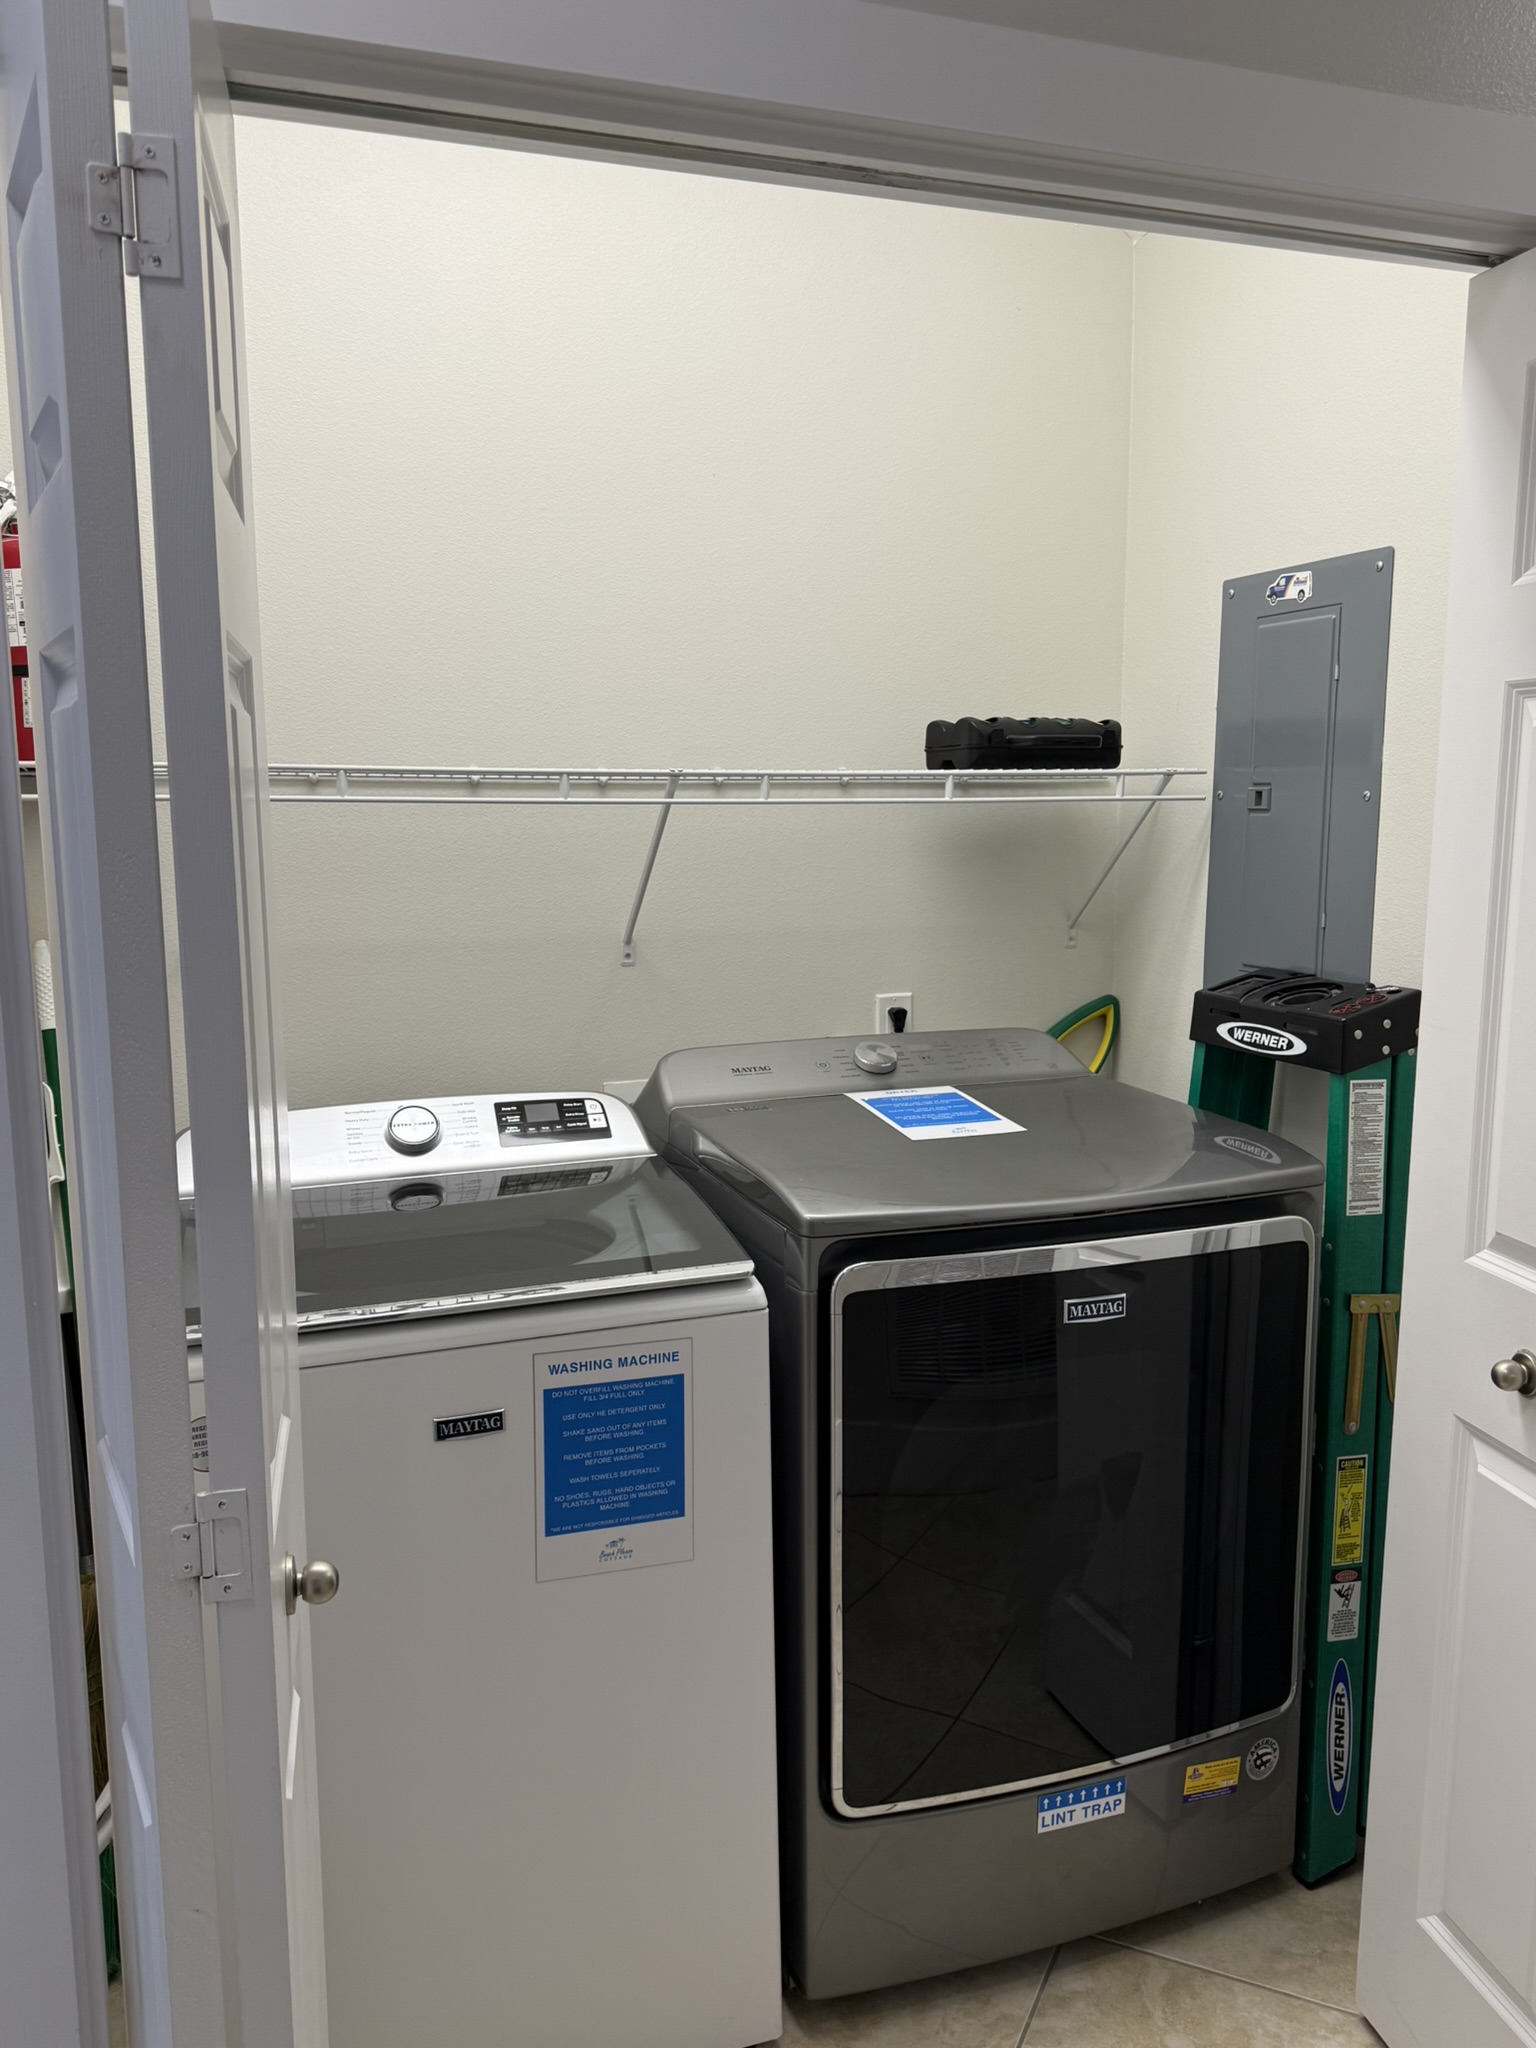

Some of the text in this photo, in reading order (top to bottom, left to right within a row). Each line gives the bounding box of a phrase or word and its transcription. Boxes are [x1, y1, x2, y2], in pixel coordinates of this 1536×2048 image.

[1233, 1027, 1290, 1050] WERNER
[730, 1065, 772, 1074] MAYTAG
[1069, 1300, 1123, 1318] MAYTAG
[548, 1351, 680, 1376] WASHING MACHINE
[552, 1391, 563, 1399] DO
[564, 1389, 578, 1397] NOT
[579, 1385, 611, 1395] OVERFILL
[612, 1381, 644, 1392] WASHING
[583, 1394, 598, 1402] FILL
[598, 1393, 609, 1401] 3/4
[610, 1391, 626, 1400] FULL
[562, 1413, 577, 1421] USE
[577, 1411, 595, 1419] ONLY
[596, 1409, 606, 1417] HE
[607, 1405, 648, 1416] DETERGENT
[438, 1416, 501, 1436] MAYTAG
[562, 1428, 586, 1437] SHAKE
[586, 1426, 606, 1434] SAND
[606, 1424, 621, 1432] OUT
[631, 1421, 646, 1429] ANY
[646, 1419, 667, 1427] ITEMS
[584, 1433, 612, 1442] BEFORE
[563, 1442, 667, 1462] REMOVE ITEMS FROM POCKETS
[584, 1457, 612, 1466] BEFORE
[569, 1476, 589, 1484] WASH
[590, 1472, 619, 1482] TOWELS
[554, 1494, 565, 1503] NO
[615, 1485, 634, 1494] HARD
[634, 1481, 665, 1492] OBJECTS
[665, 1480, 676, 1488] OR
[562, 1498, 595, 1509] PLASTICS
[596, 1494, 629, 1504] ALLOWED
[637, 1488, 668, 1498] WASHING
[1334, 1691, 1346, 1781] WERNER
[1250, 1738, 1278, 1757] AMERICA
[1041, 1798, 1122, 1828] LINT TRAP
